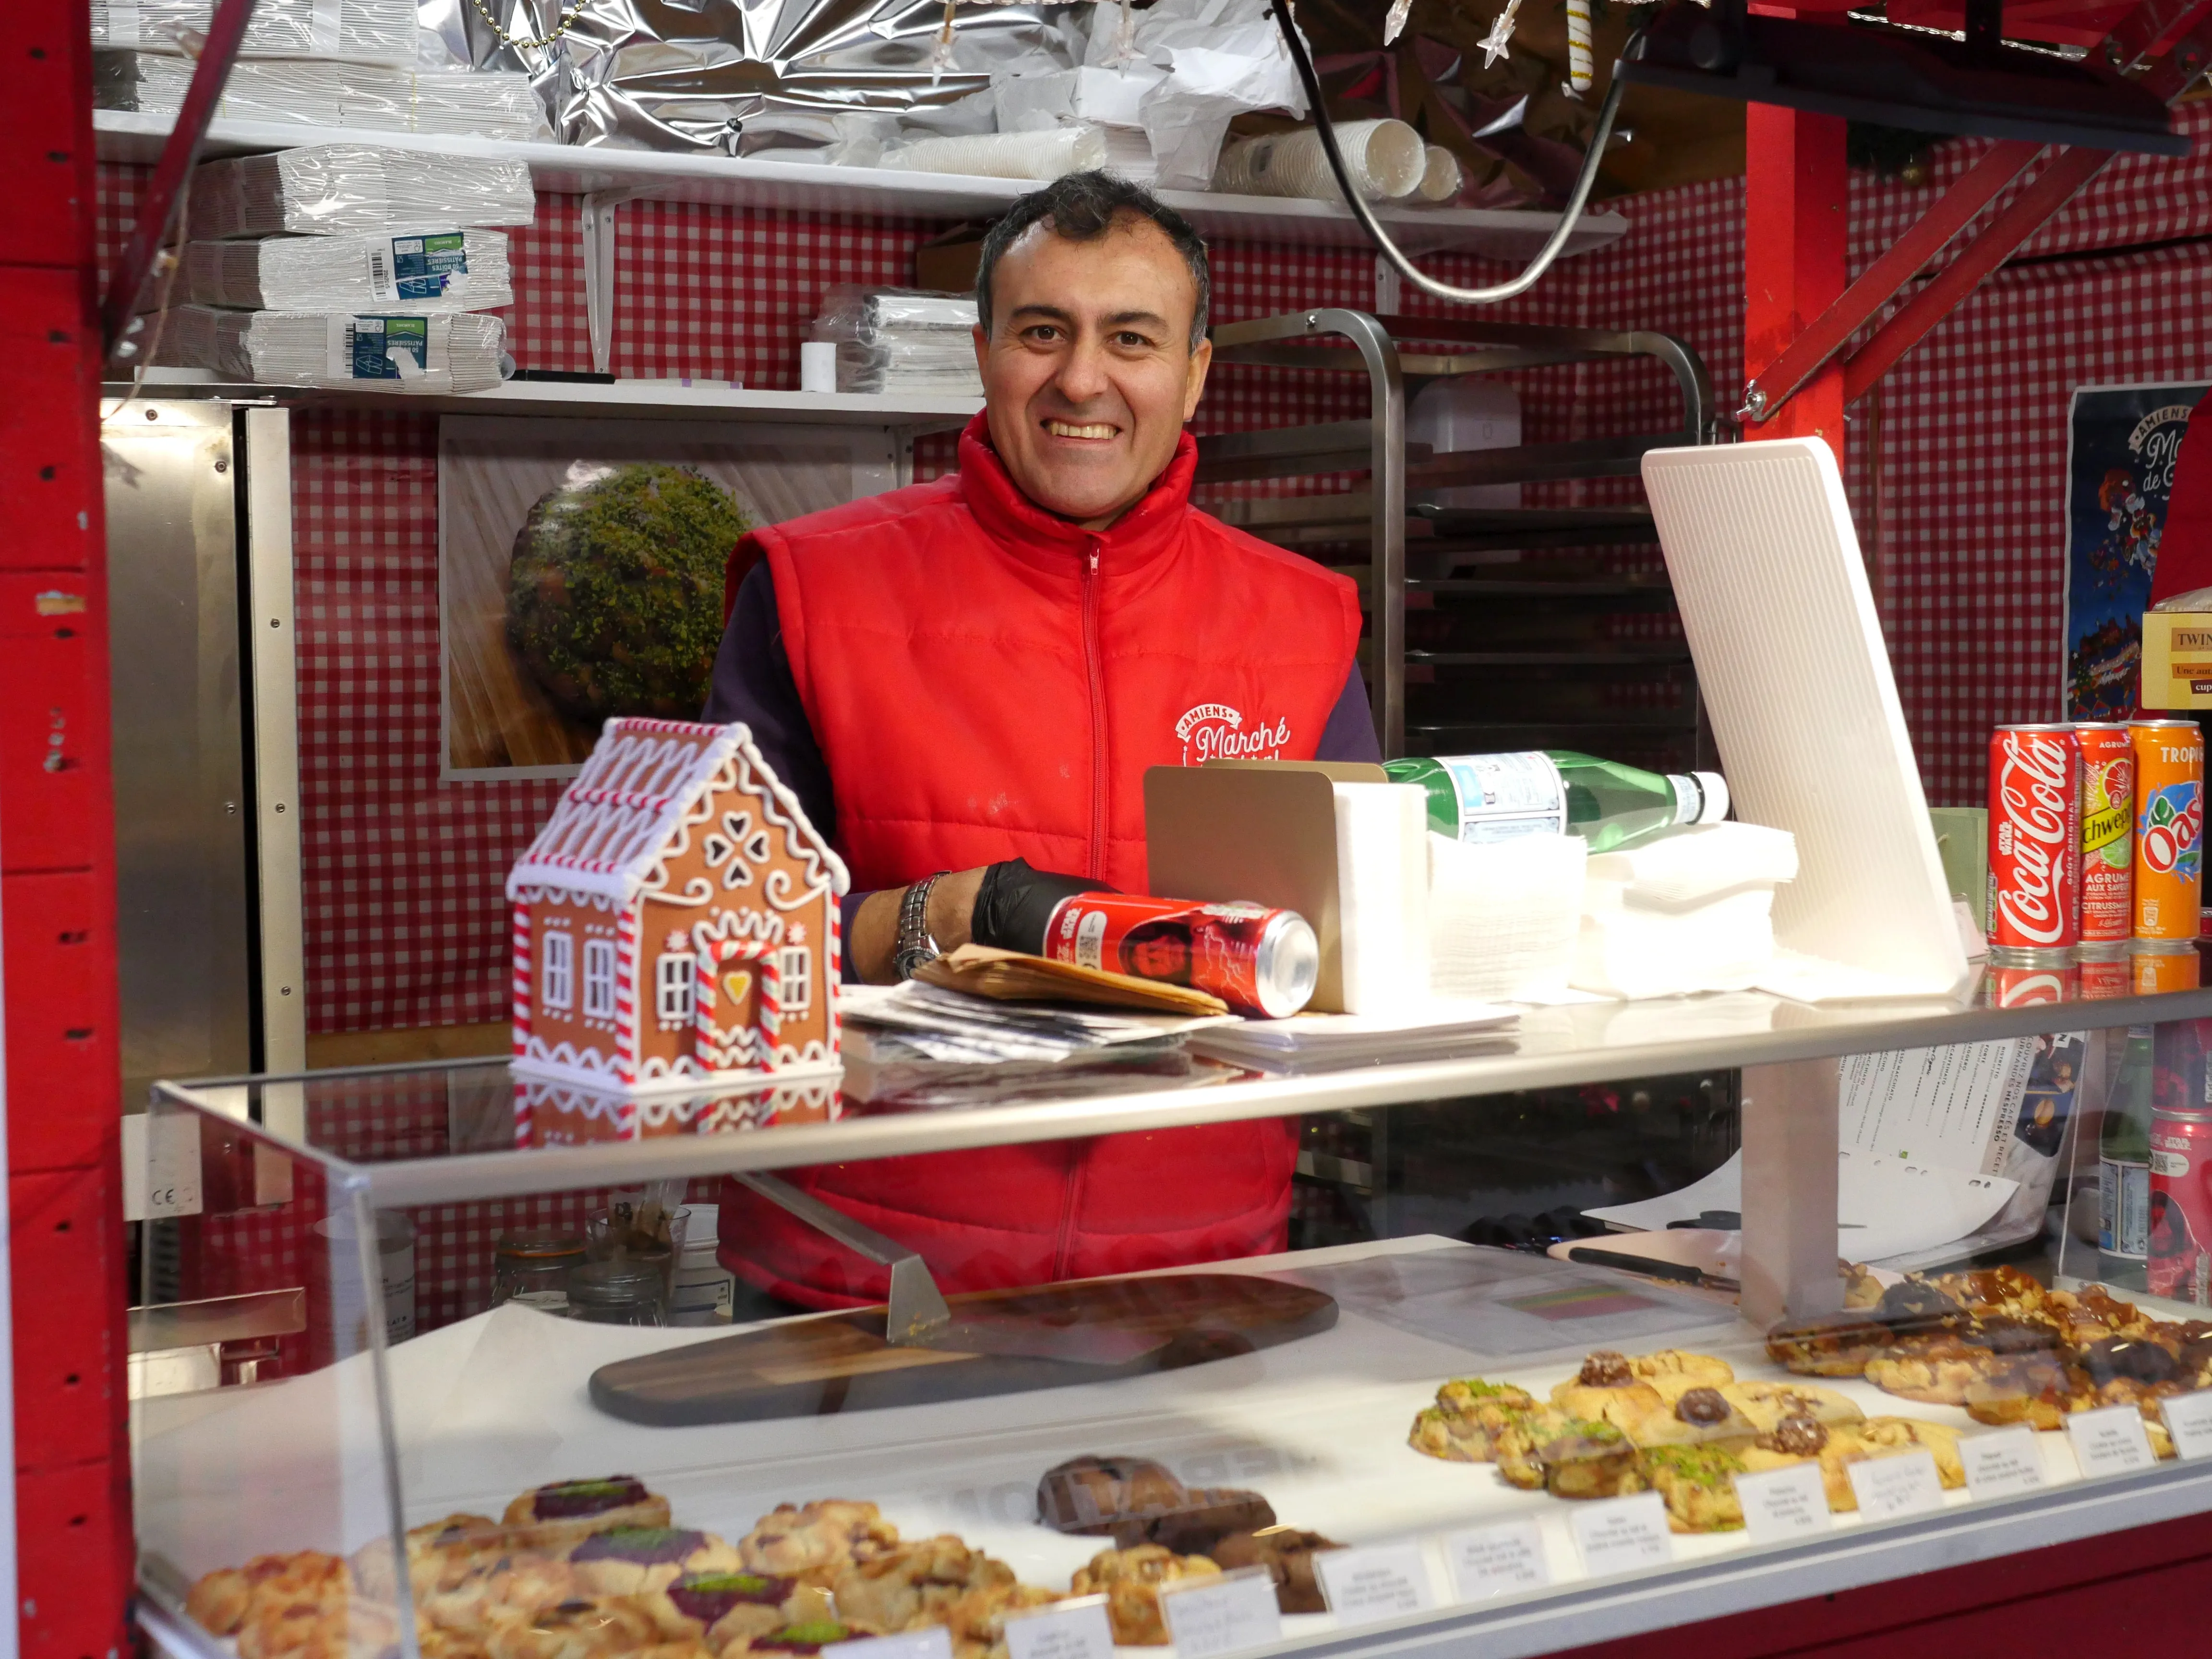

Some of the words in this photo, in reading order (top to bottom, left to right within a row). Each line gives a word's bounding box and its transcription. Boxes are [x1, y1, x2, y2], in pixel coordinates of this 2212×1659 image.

[2139, 408, 2188, 437] AMIENS
[2143, 471, 2162, 492] de
[1184, 705, 1228, 729] AMIENS
[1196, 716, 1291, 762] Marché
[1998, 731, 2067, 943] Coca-Cola
[2067, 800, 2075, 852] ORIGINAL
[2086, 884, 2105, 892] AUX
[1941, 1044, 1956, 1085] ECAFFEINATO
[1962, 1042, 1973, 1071] LEGGERO
[1981, 1044, 1989, 1063] FORTE
[1994, 1046, 2006, 1079] RISTRETTO
[2008, 1037, 2026, 1088] URMANDES
[2018, 1036, 2034, 1078] COUVREZ
[1888, 1065, 1901, 1101] MACCHIATO
[2012, 1081, 2022, 1100] NOS
[1993, 1091, 2012, 1142] NESPRESSO
[2003, 1103, 2016, 1130] CAFÉS
[2000, 1132, 2008, 1143] ET
[152, 1188, 176, 1205] CE
